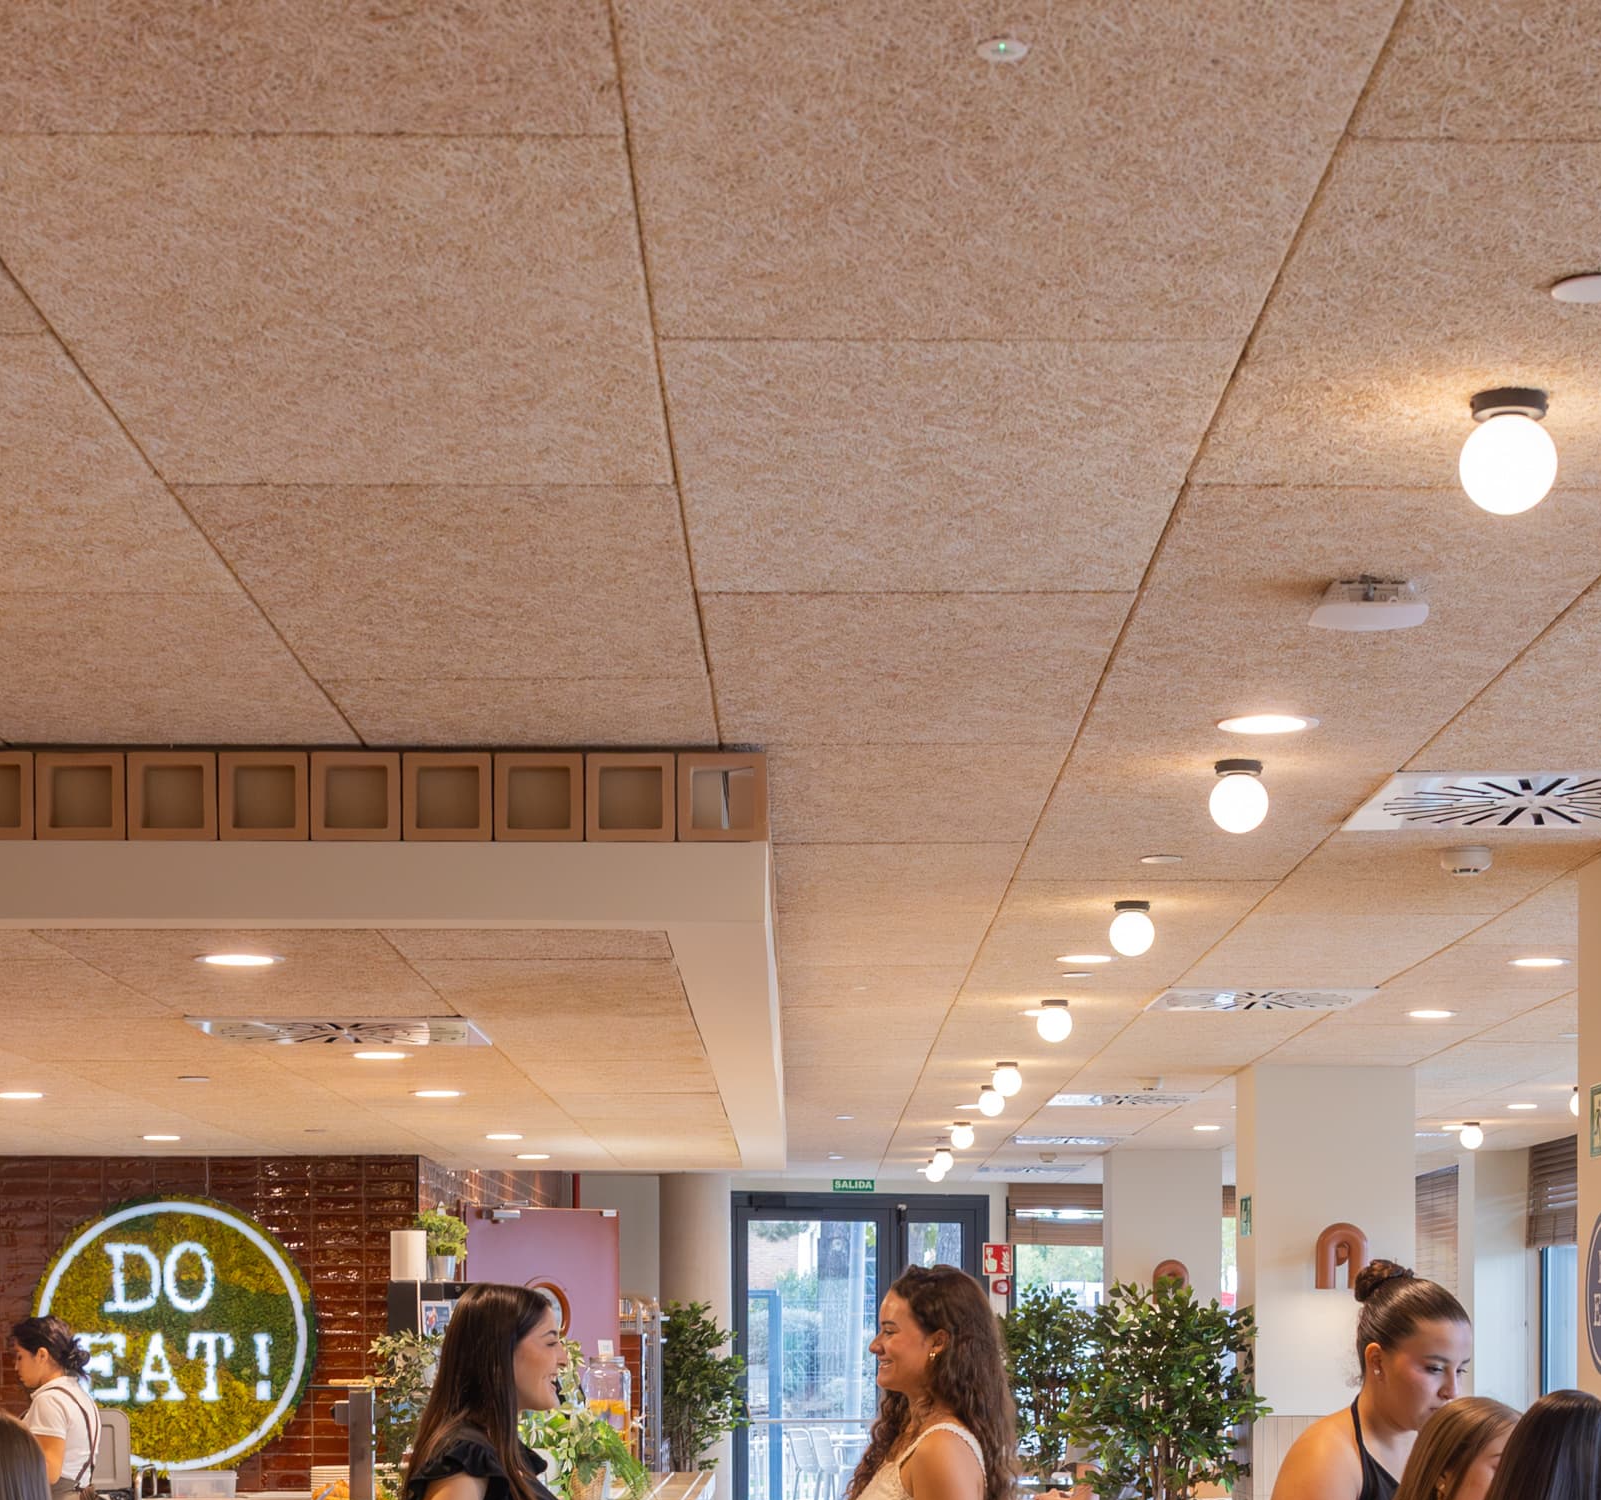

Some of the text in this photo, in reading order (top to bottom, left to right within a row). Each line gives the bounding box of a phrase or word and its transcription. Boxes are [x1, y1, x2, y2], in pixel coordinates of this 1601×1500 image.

[834, 1180, 873, 1189] SALIDA
[103, 1241, 215, 1313] DO
[73, 1332, 273, 1402] EAT!
